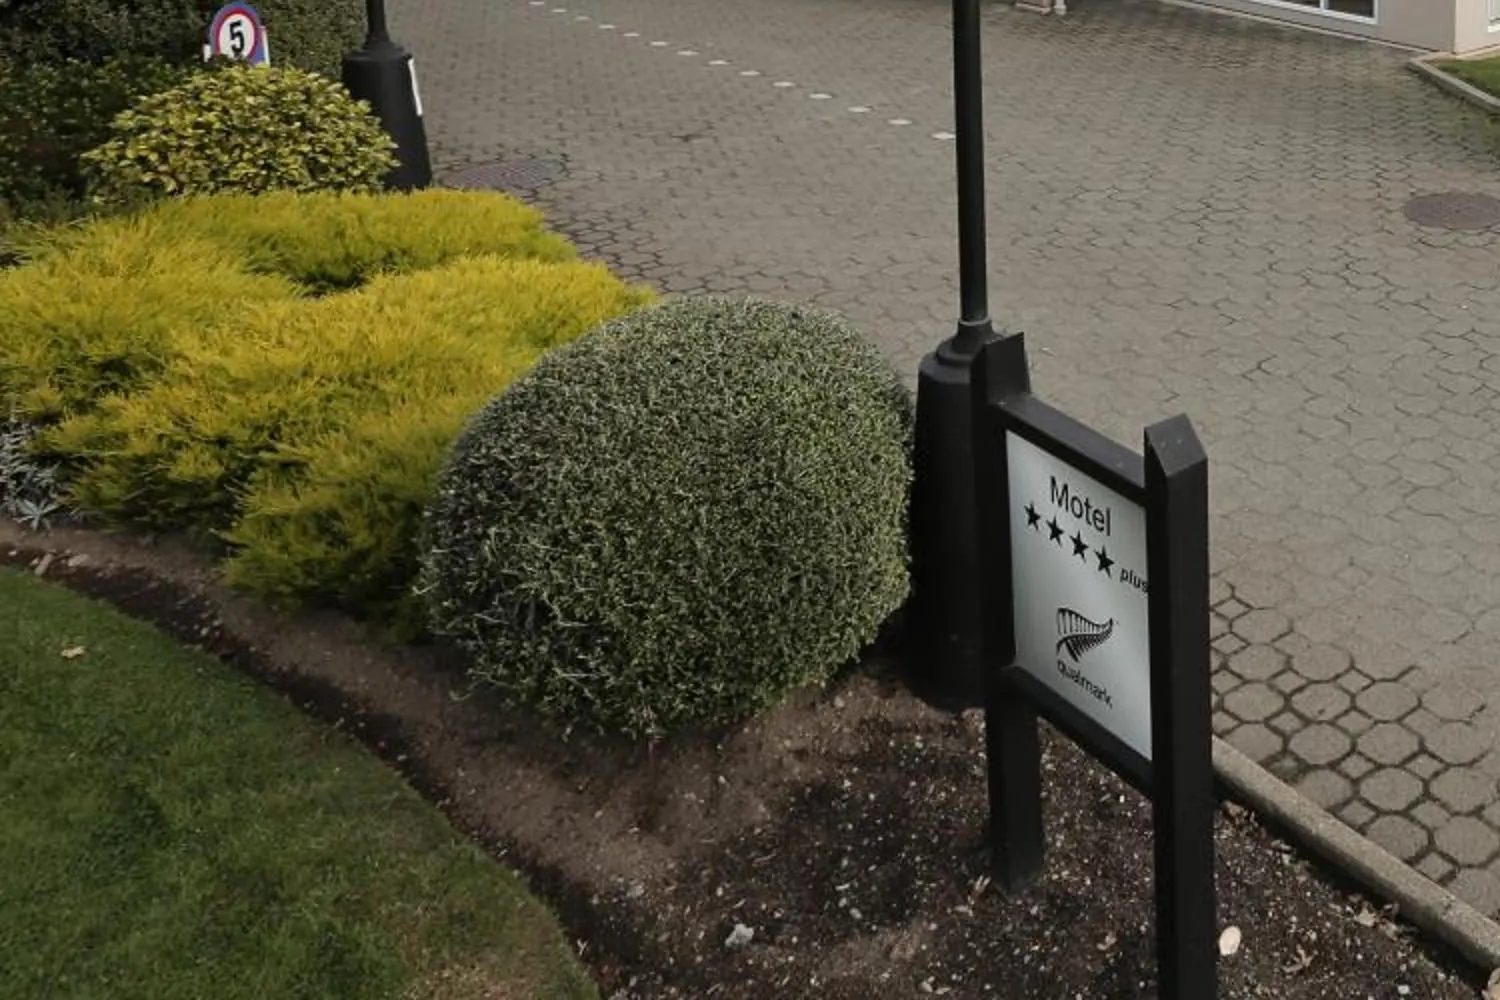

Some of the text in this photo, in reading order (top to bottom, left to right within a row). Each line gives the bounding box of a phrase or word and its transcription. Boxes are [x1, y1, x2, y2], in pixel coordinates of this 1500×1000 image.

[229, 19, 245, 58] 5
[1049, 475, 1112, 537] Motel
[1119, 567, 1149, 593] plus
